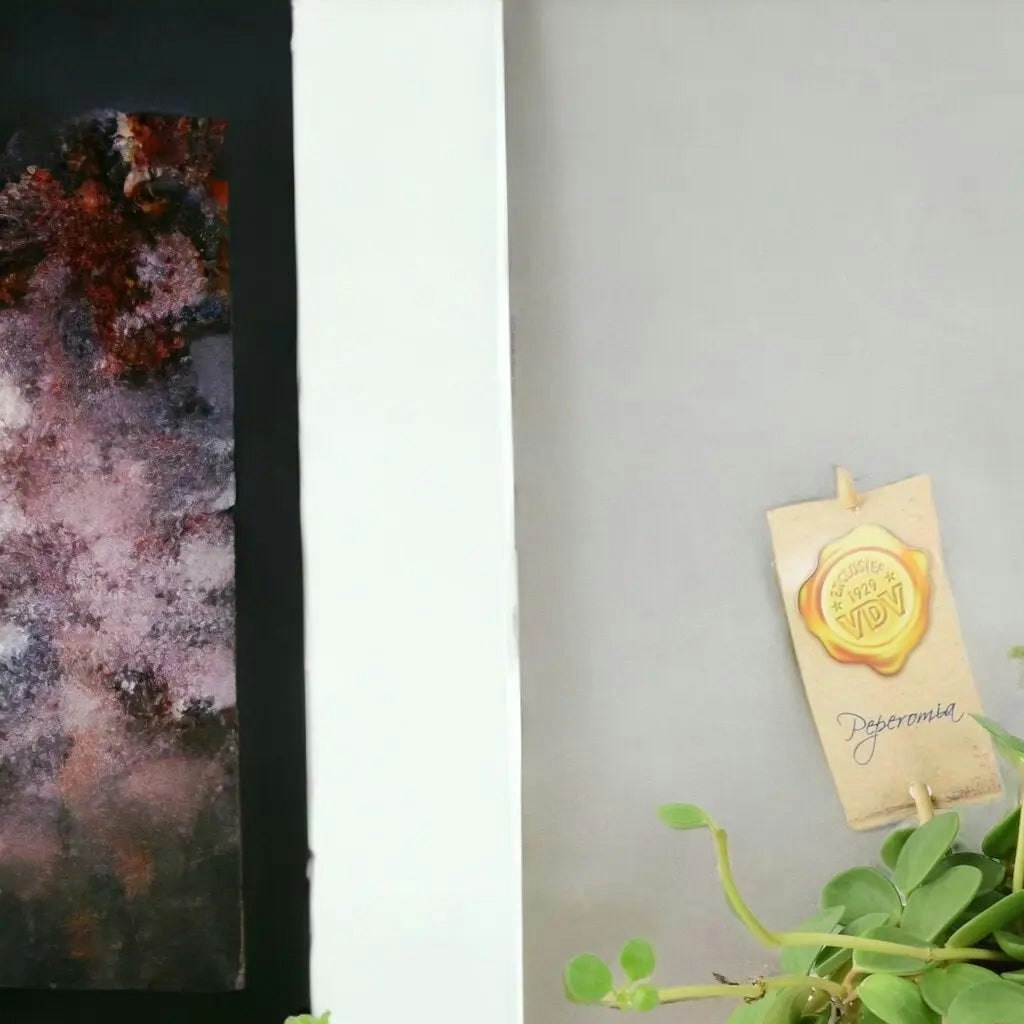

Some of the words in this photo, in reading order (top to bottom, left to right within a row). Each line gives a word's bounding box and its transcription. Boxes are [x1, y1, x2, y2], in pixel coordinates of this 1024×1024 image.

[835, 582, 906, 640] VDV
[848, 579, 878, 603] 1929
[837, 703, 965, 765] Peperomia
